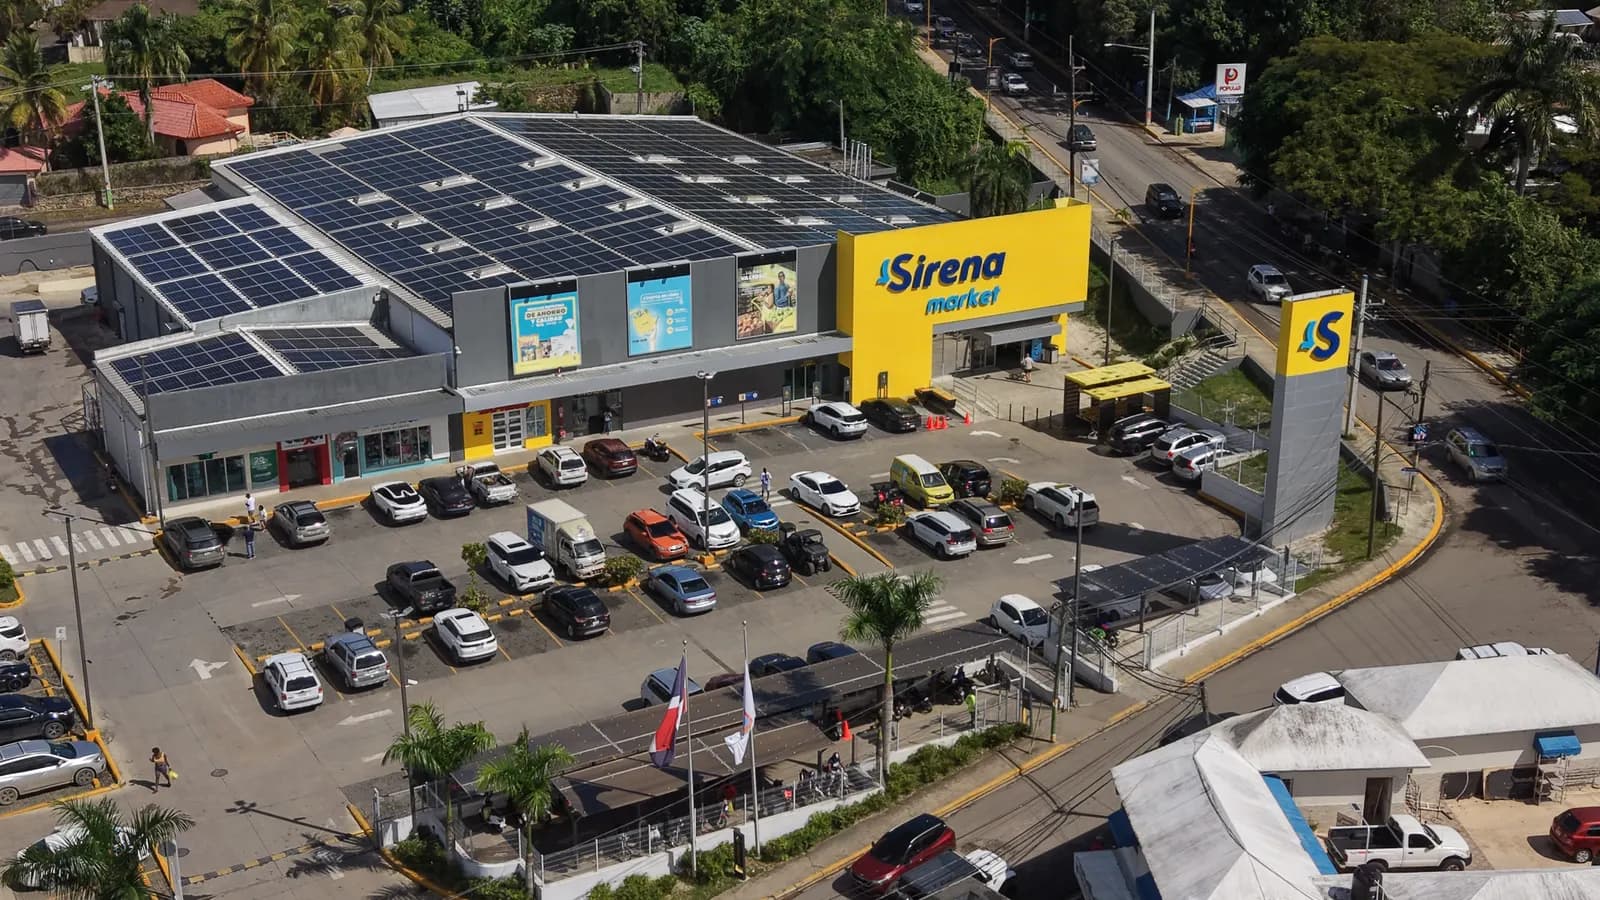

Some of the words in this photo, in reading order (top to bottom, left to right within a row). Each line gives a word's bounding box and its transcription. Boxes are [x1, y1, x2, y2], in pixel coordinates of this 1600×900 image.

[886, 251, 1006, 293] Sirena
[537, 308, 566, 316] AHORRO
[925, 285, 1001, 315] market
